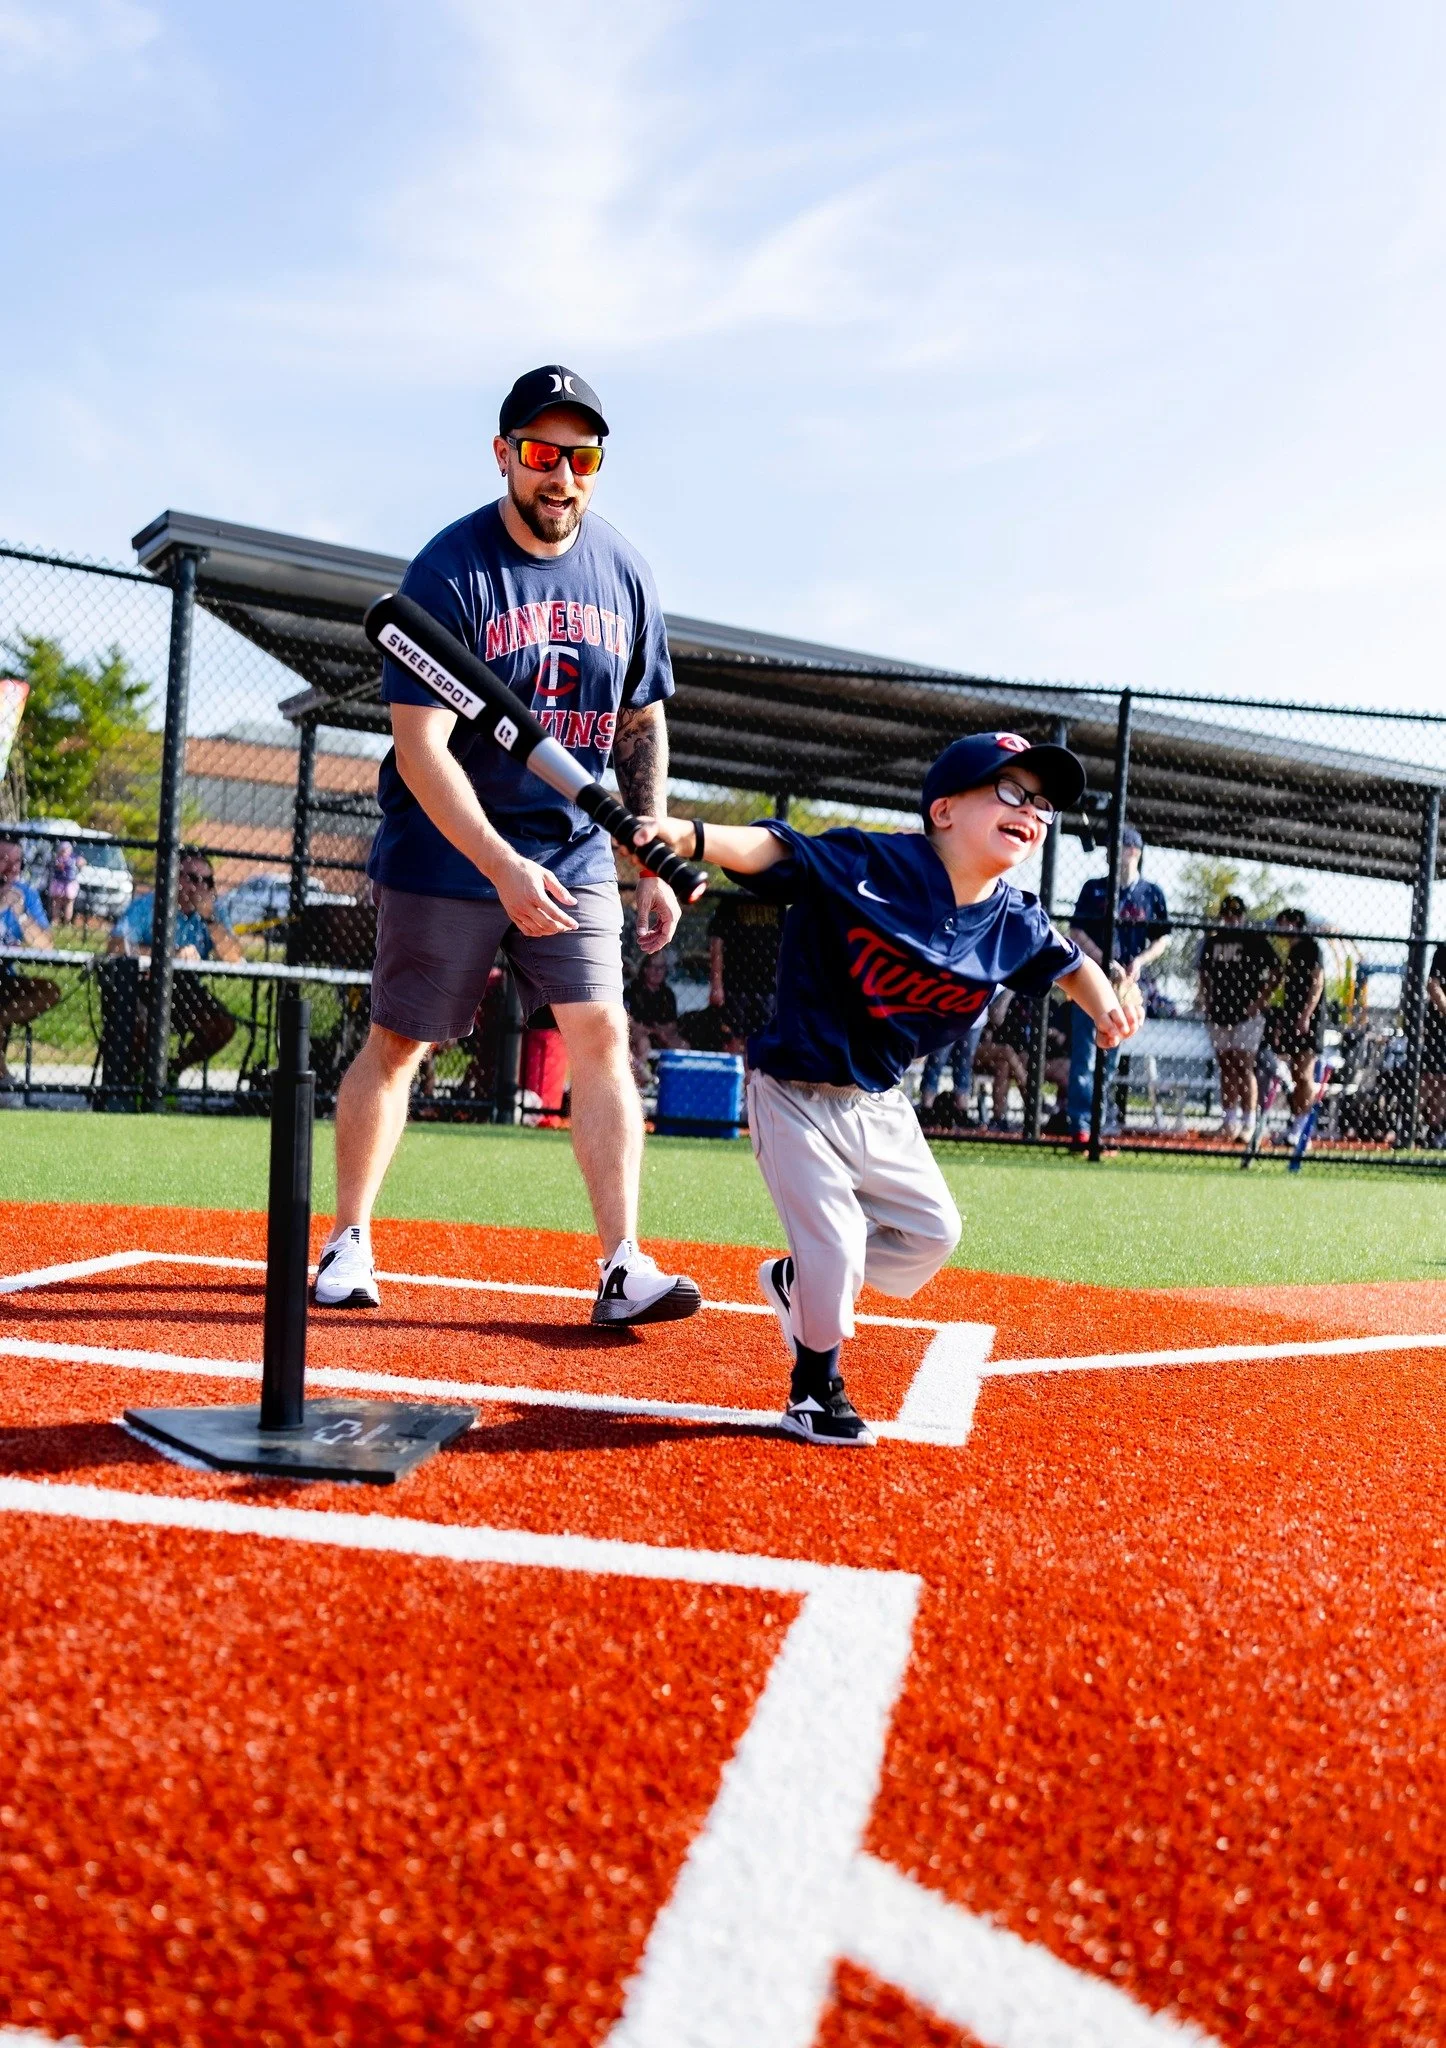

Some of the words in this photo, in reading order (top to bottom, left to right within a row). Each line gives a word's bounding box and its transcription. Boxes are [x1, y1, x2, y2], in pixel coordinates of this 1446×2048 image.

[387, 632, 474, 709] SWEETSPOT
[529, 709, 617, 750] INS
[847, 927, 990, 1018] Twins
[350, 1228, 360, 1244] PU
